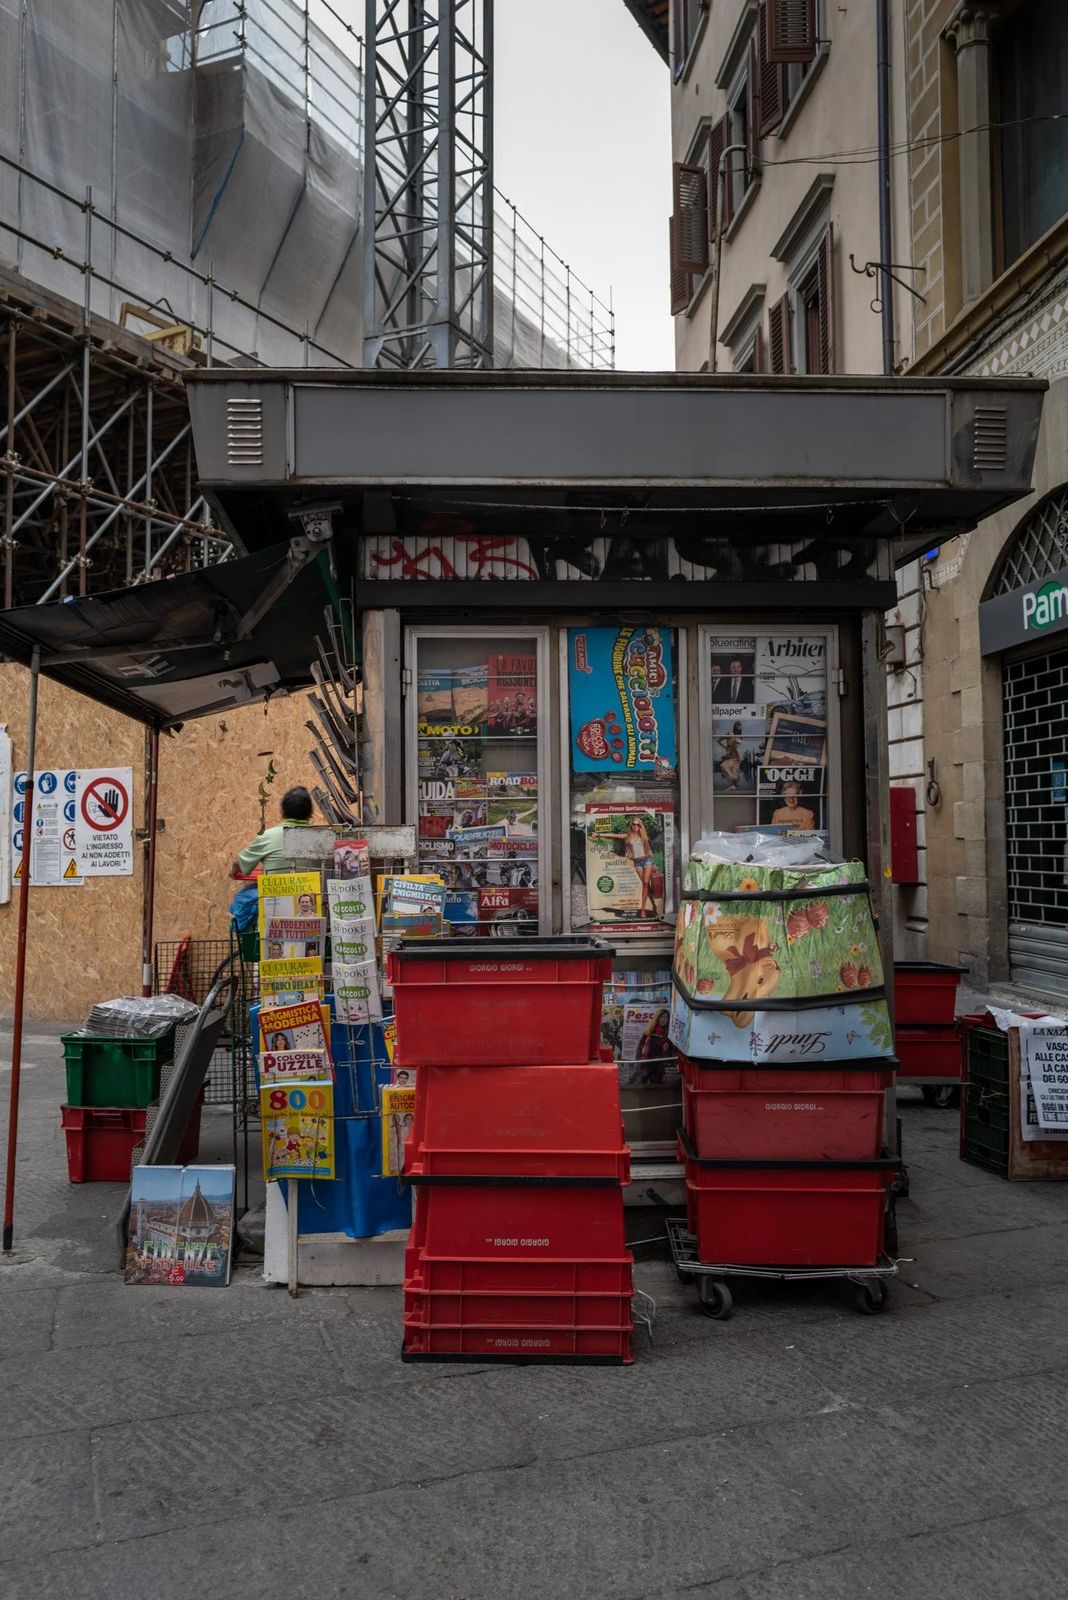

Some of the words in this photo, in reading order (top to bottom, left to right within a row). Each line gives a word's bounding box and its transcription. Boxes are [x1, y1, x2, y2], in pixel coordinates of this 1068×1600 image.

[1022, 586, 1068, 630] Pam
[761, 636, 825, 657] Arbiter
[612, 637, 628, 675] FIGURINE
[511, 659, 537, 672] FAVO
[647, 649, 659, 687] AMICI
[615, 675, 625, 689] CHE
[619, 689, 633, 724] SALVANO
[628, 641, 658, 761] CUCCIOLOTTI
[626, 724, 635, 736] GLI
[625, 736, 638, 768] ANIMALI
[767, 768, 816, 783] OGGI
[489, 776, 537, 787] ROADBO
[86, 842, 124, 850] L'INGRESSO
[103, 850, 130, 858] ADDETTI
[90, 860, 97, 868] AI
[261, 876, 302, 888] CULTURA
[330, 882, 364, 893] SUDOKU
[261, 884, 313, 895] ENIGMISTICA
[391, 888, 443, 903] ENIGMISTICA
[446, 895, 462, 904] utto
[481, 895, 509, 906] Alfa
[333, 904, 366, 914] RACCOLTA
[268, 919, 321, 930] AUTODEFINITI
[332, 924, 367, 935] SUDOKU
[268, 928, 284, 939] PER
[285, 929, 308, 939] TUTTI
[335, 945, 367, 954] RACCOLTA
[261, 960, 304, 972] CULTURA
[469, 963, 498, 972] GIORGIO
[500, 963, 524, 971] GIORGI
[334, 968, 369, 978] SUDOKU
[292, 979, 315, 990] RELAX
[338, 989, 370, 998] RACCOLTA
[261, 1004, 318, 1024] ENIGMISTICA
[264, 1013, 320, 1033] MODERNA
[1032, 1027, 1045, 1036] LA
[763, 1029, 832, 1055] Lindt
[276, 1053, 322, 1062] COLOSSAL
[1035, 1052, 1054, 1062] ALLE
[263, 1053, 323, 1073] PUZZLE
[1042, 1063, 1052, 1073] LA
[1042, 1074, 1057, 1083] DEI
[269, 1089, 325, 1110] 800
[765, 1102, 792, 1111] GIORGIO
[793, 1102, 817, 1111] GIORGI
[494, 1237, 519, 1247] GIORGI
[520, 1237, 550, 1247] GIORGIO
[139, 1239, 218, 1273] FIRENZE
[495, 1338, 519, 1348] GIORGI
[521, 1338, 551, 1348] GIORGIO
